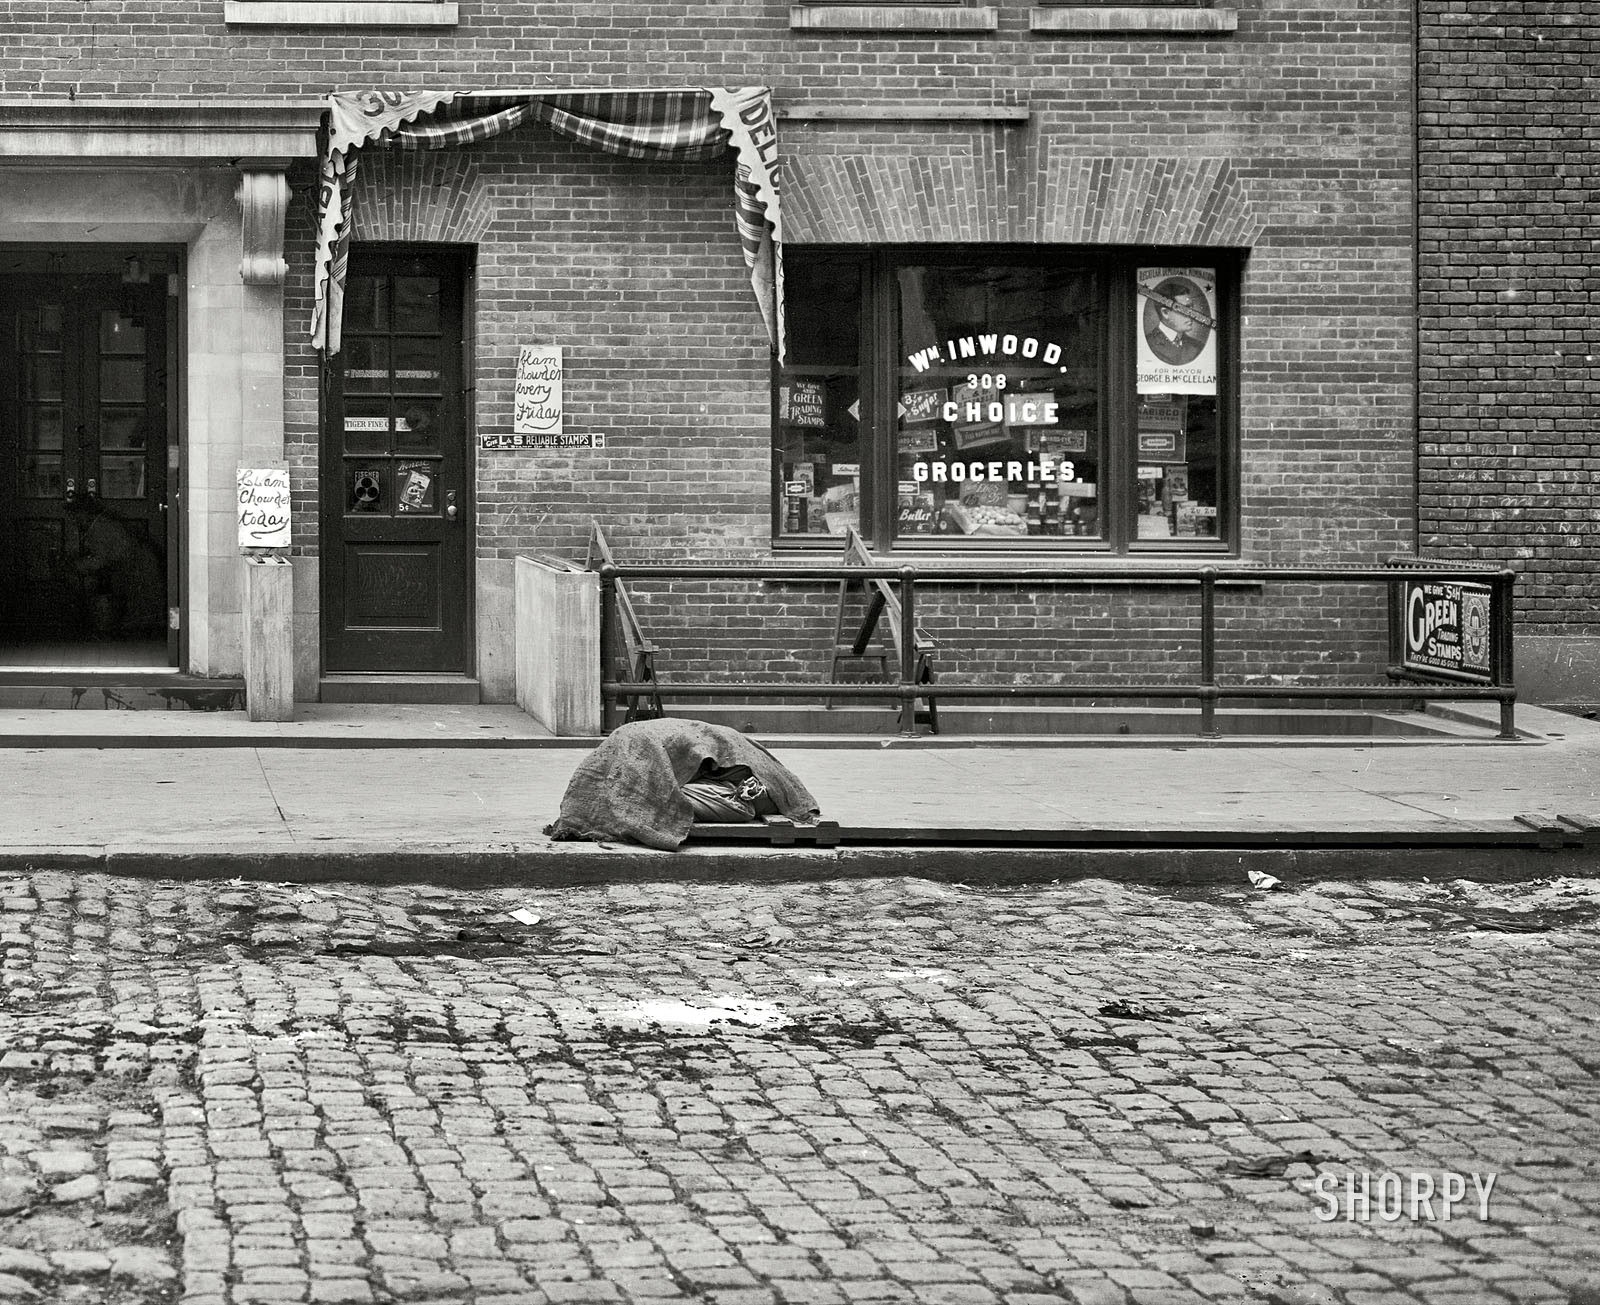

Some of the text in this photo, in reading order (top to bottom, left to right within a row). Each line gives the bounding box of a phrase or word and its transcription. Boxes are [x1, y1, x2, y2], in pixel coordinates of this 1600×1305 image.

[967, 374, 1007, 389] 308
[1137, 374, 1163, 383] GEORGE
[793, 393, 823, 405] GREEN
[910, 392, 937, 415] Sugar
[790, 405, 822, 420] TRADING
[943, 401, 1059, 422] CHOICE
[345, 419, 366, 428] TIGER
[367, 419, 384, 428] FINE
[797, 415, 825, 427] STAMPS
[526, 435, 558, 445] RELIABLE
[560, 435, 589, 445] STAMPS
[913, 461, 1083, 483] GROCERIES.
[900, 508, 932, 521] Butter
[238, 510, 290, 539] today
[1423, 584, 1432, 594] WE
[1432, 585, 1444, 596] GIVE
[1408, 587, 1457, 652] GREEN
[1437, 627, 1459, 643] TRADING
[1428, 637, 1462, 661] STAMPS
[1410, 651, 1428, 664] THEY'RE
[1428, 656, 1440, 666] GOOD
[1440, 659, 1447, 667] AS
